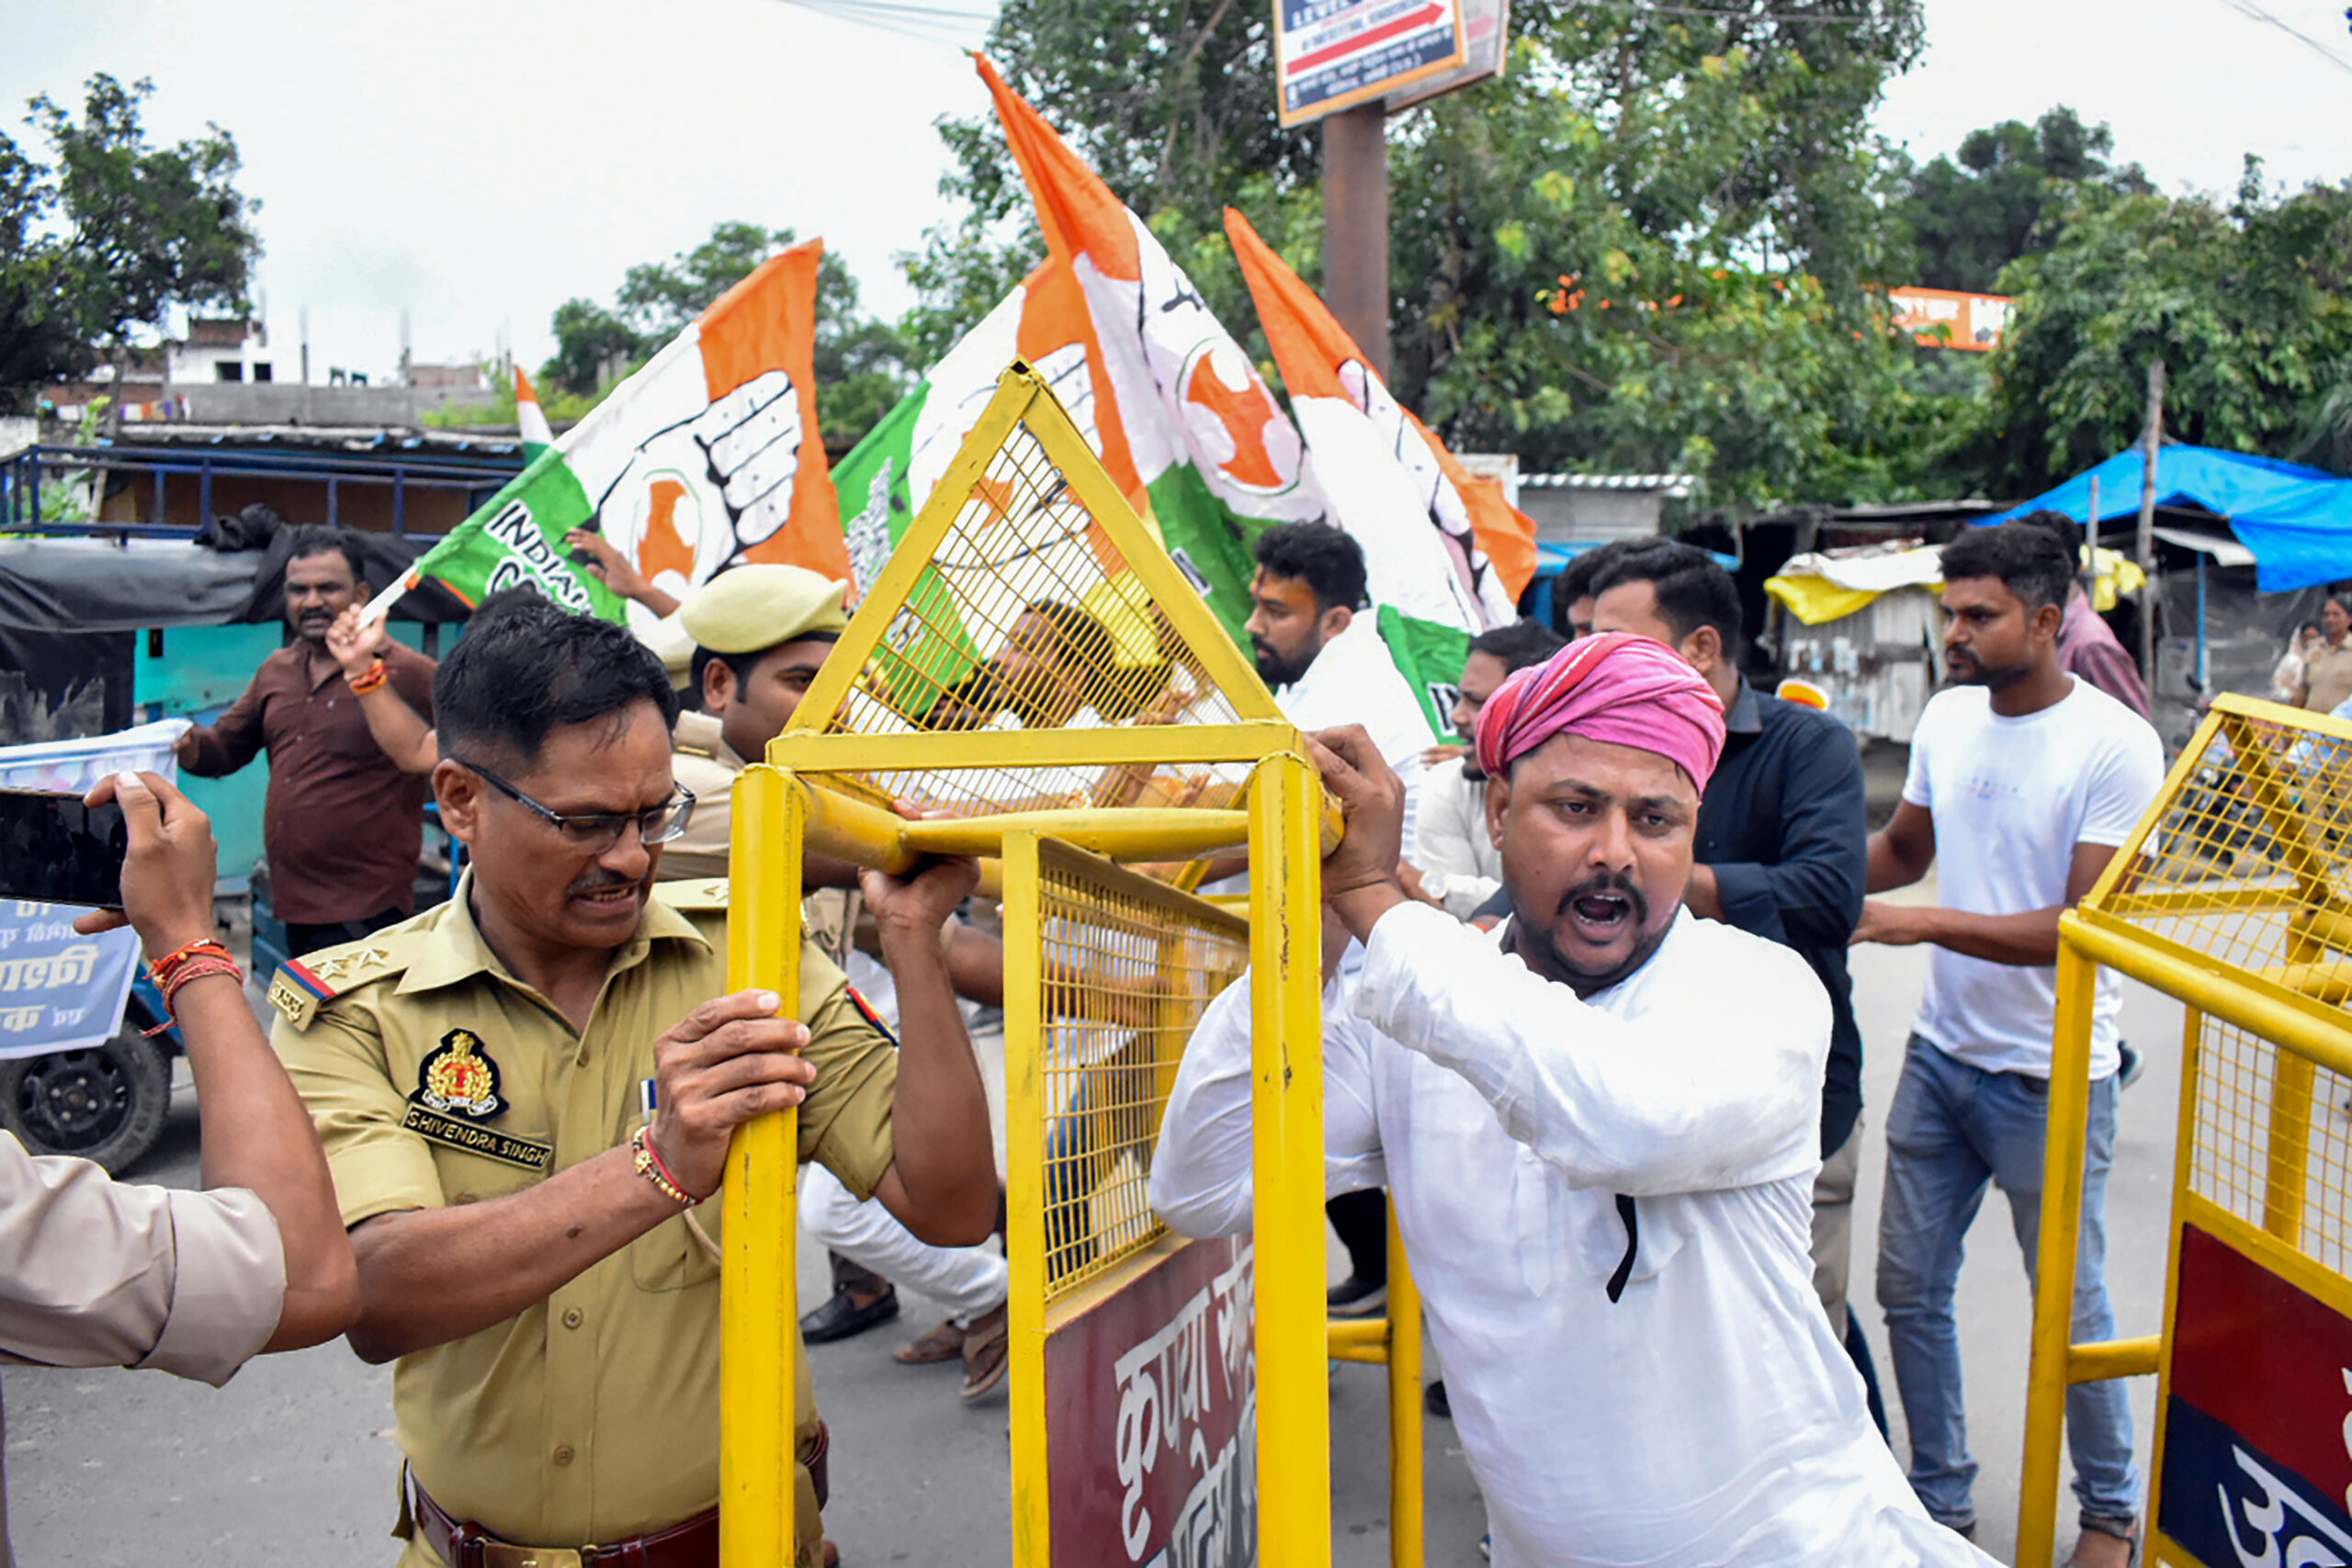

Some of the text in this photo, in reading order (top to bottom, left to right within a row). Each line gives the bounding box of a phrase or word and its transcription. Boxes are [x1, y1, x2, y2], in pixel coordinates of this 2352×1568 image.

[406, 1111, 548, 1164] SHIVENDRA SINGH
[1114, 1286, 1211, 1562] कृपया
